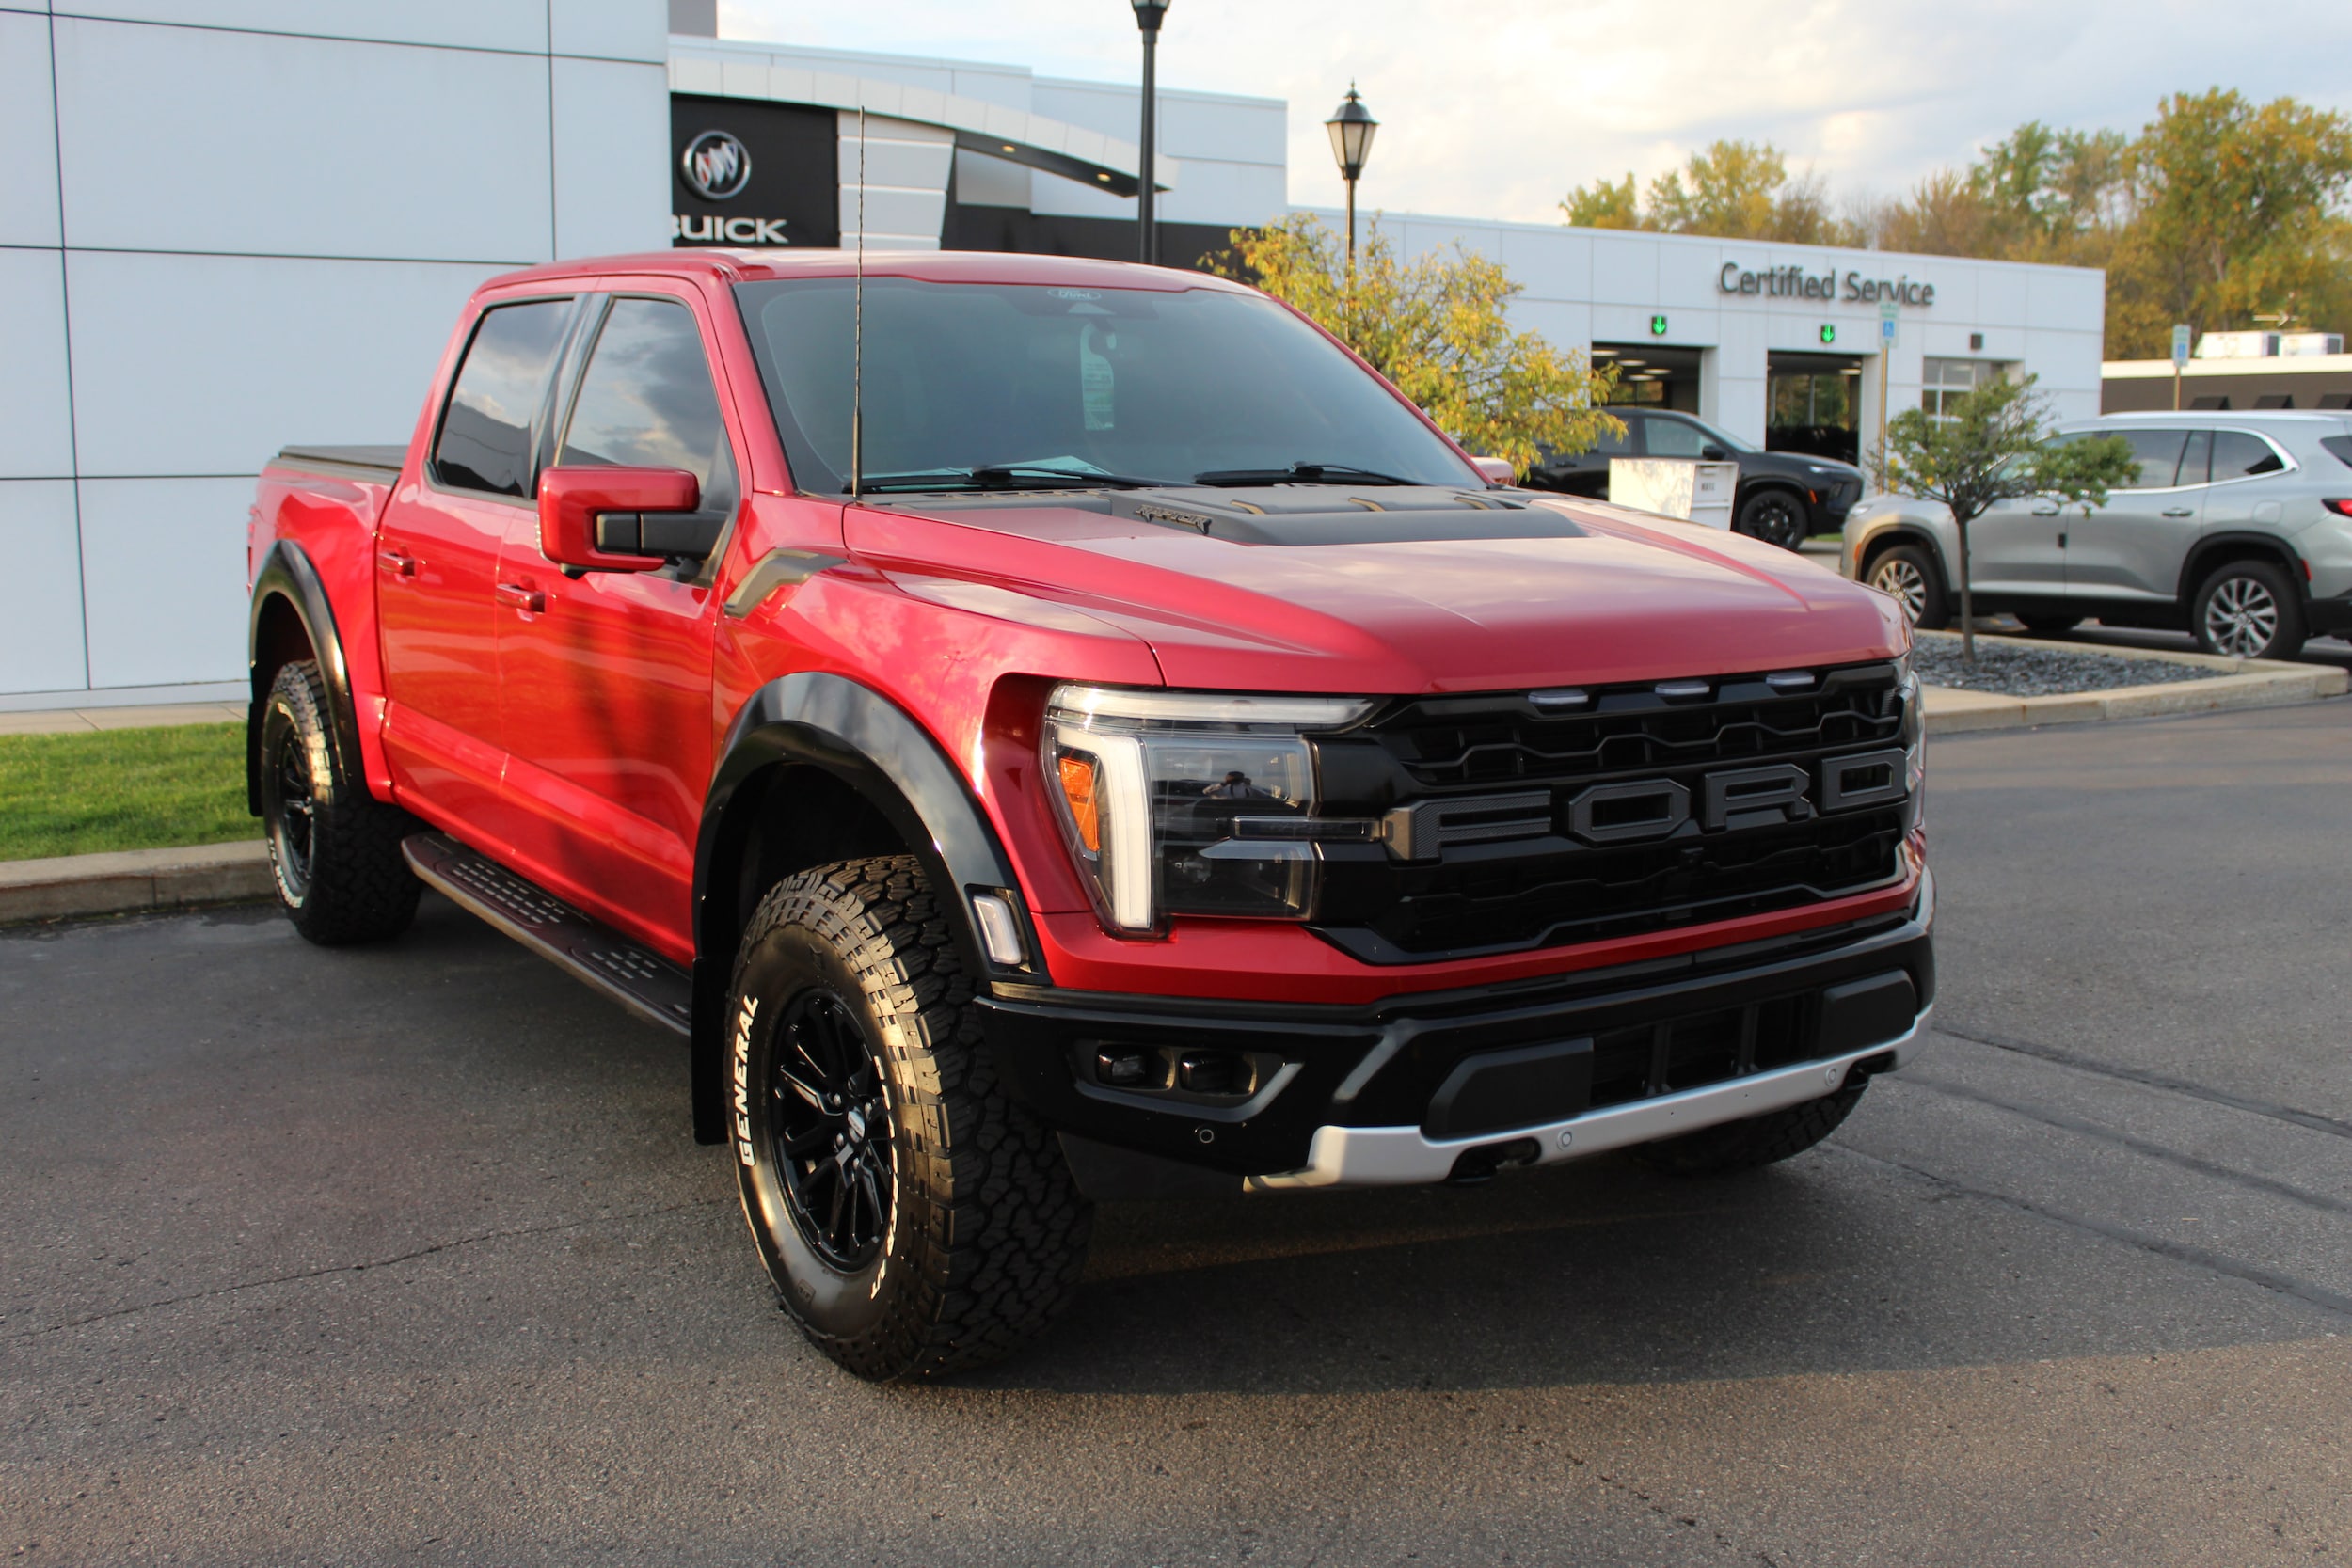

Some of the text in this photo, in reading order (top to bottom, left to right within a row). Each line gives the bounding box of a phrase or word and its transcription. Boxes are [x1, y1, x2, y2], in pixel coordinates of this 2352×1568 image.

[1720, 261, 1935, 306] Certified Service
[1382, 747, 1907, 861] FORD
[734, 994, 759, 1167] GENERAL
